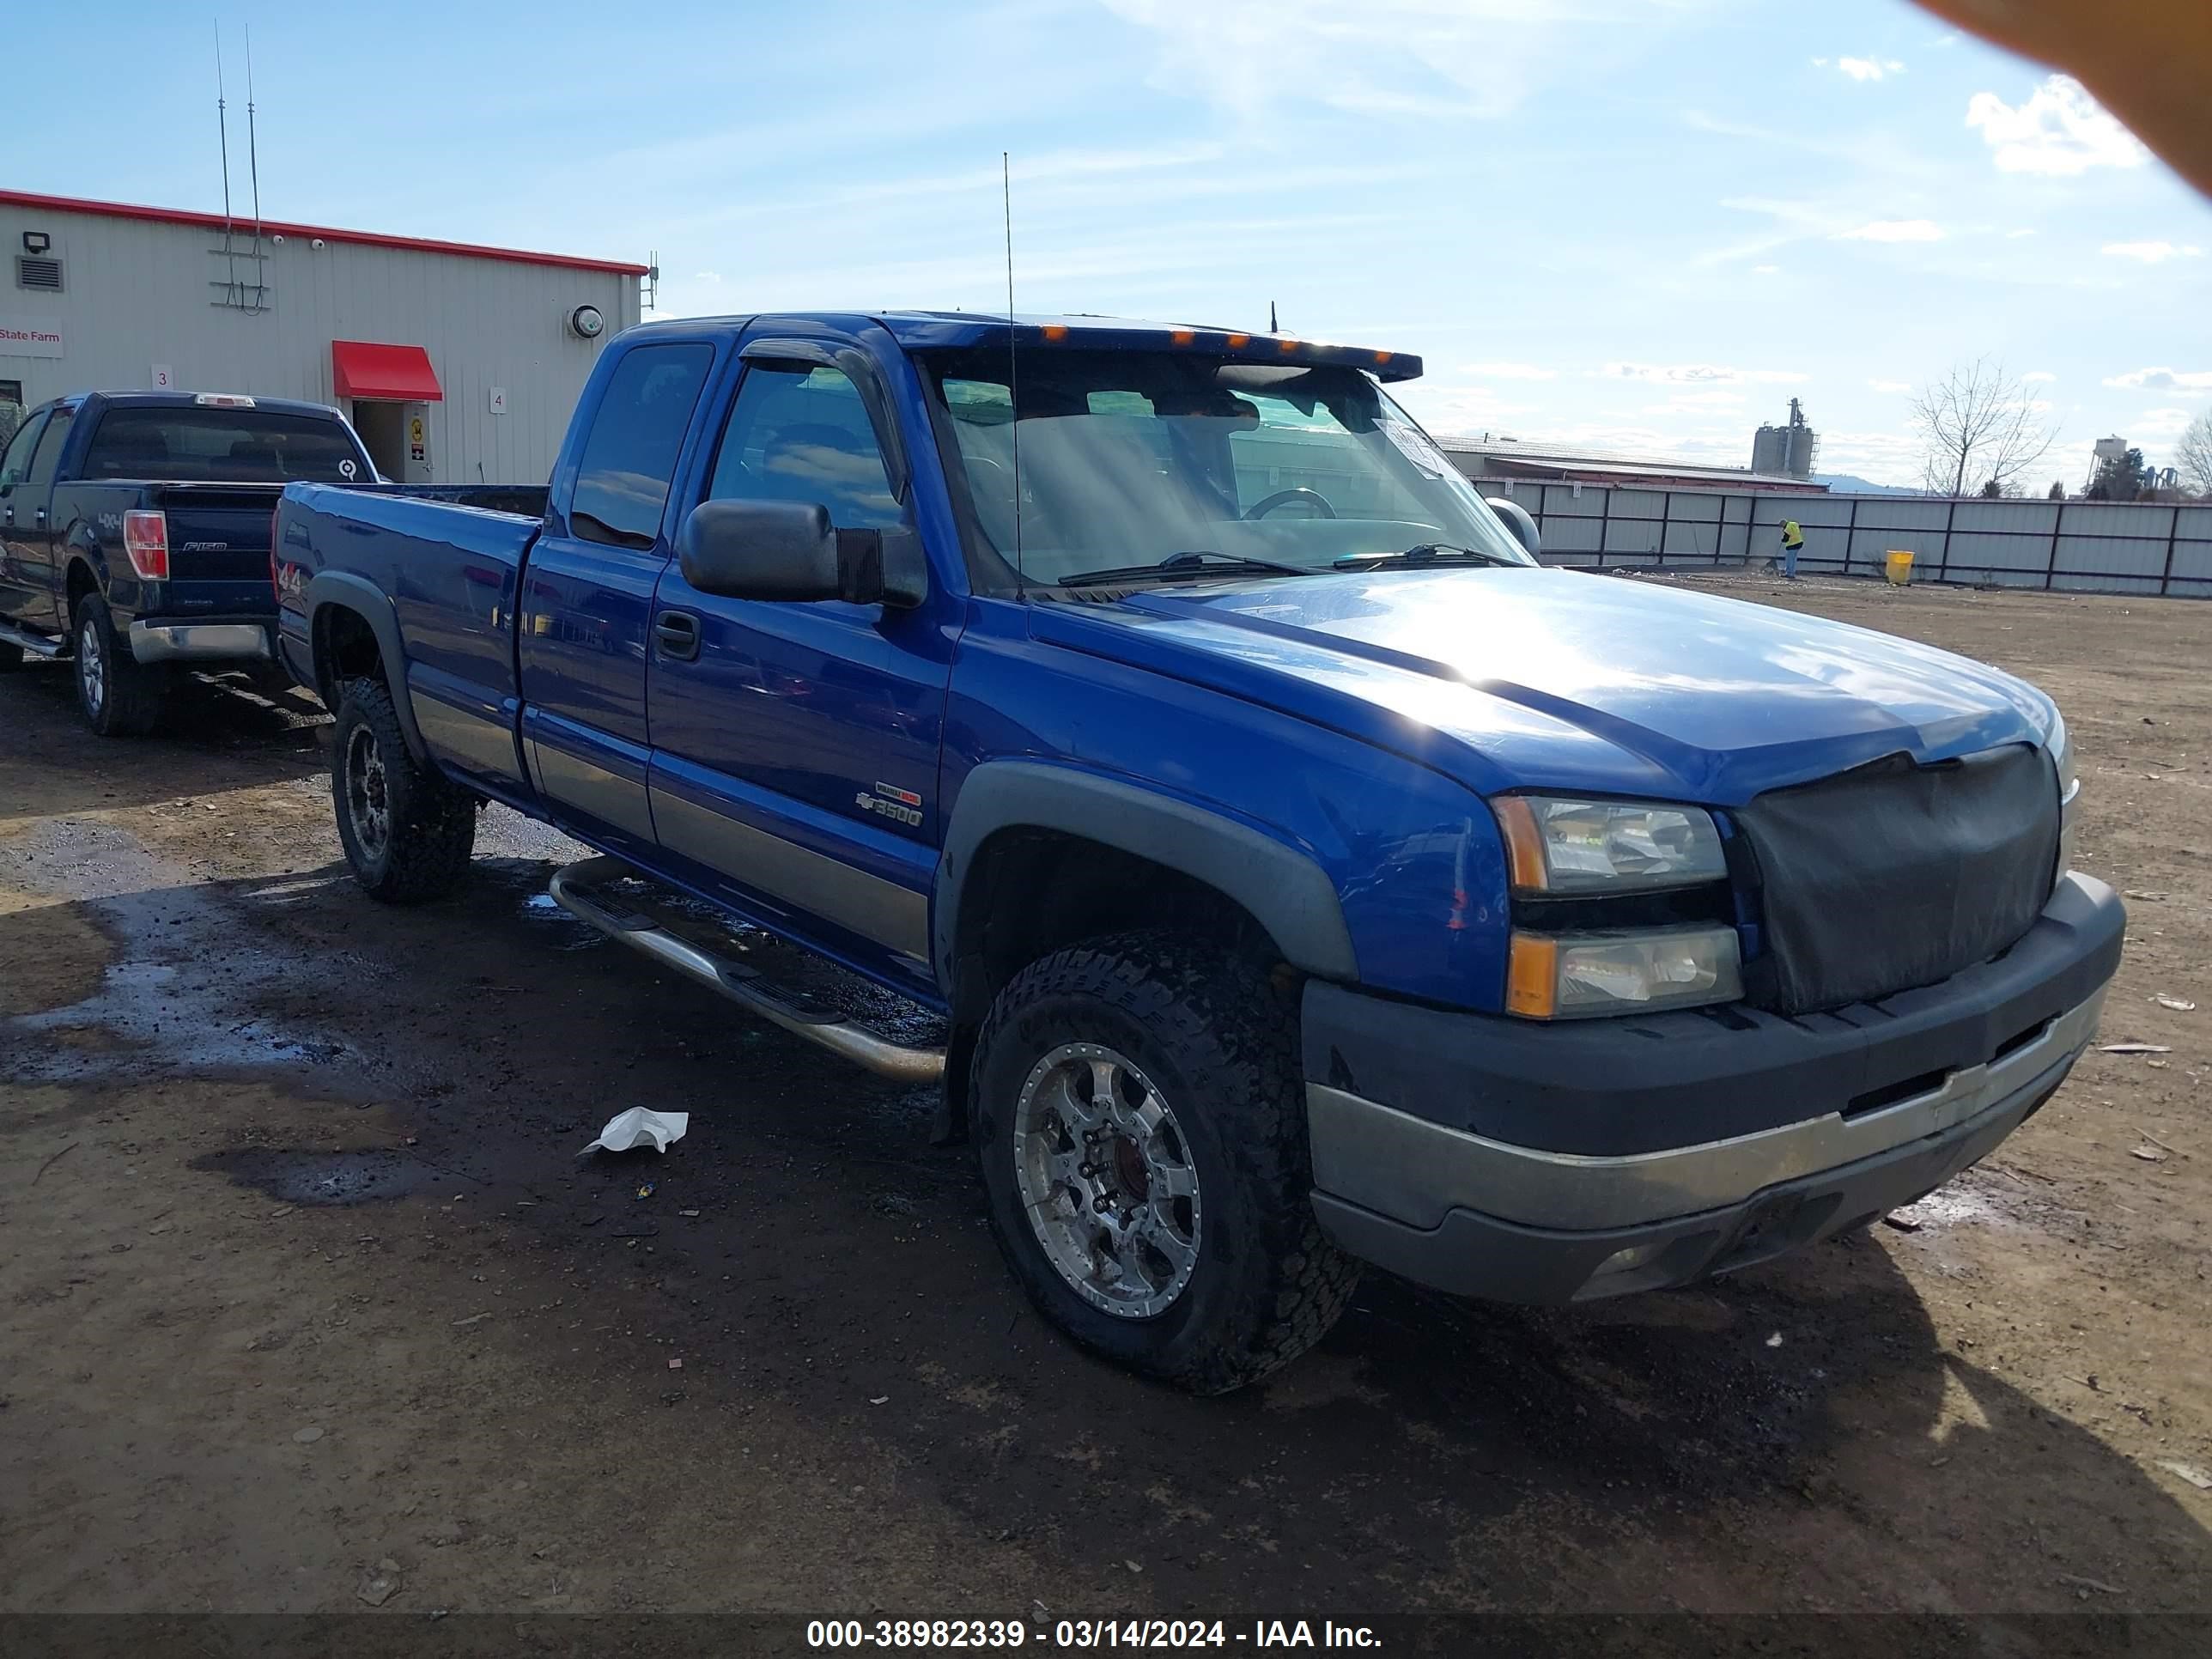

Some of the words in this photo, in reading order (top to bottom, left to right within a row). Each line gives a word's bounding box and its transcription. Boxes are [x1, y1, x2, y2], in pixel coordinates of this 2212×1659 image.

[0, 329, 28, 340] State
[31, 331, 59, 342] Farm
[159, 373, 167, 385] 3
[495, 394, 501, 405] 4
[875, 799, 922, 827] 3500
